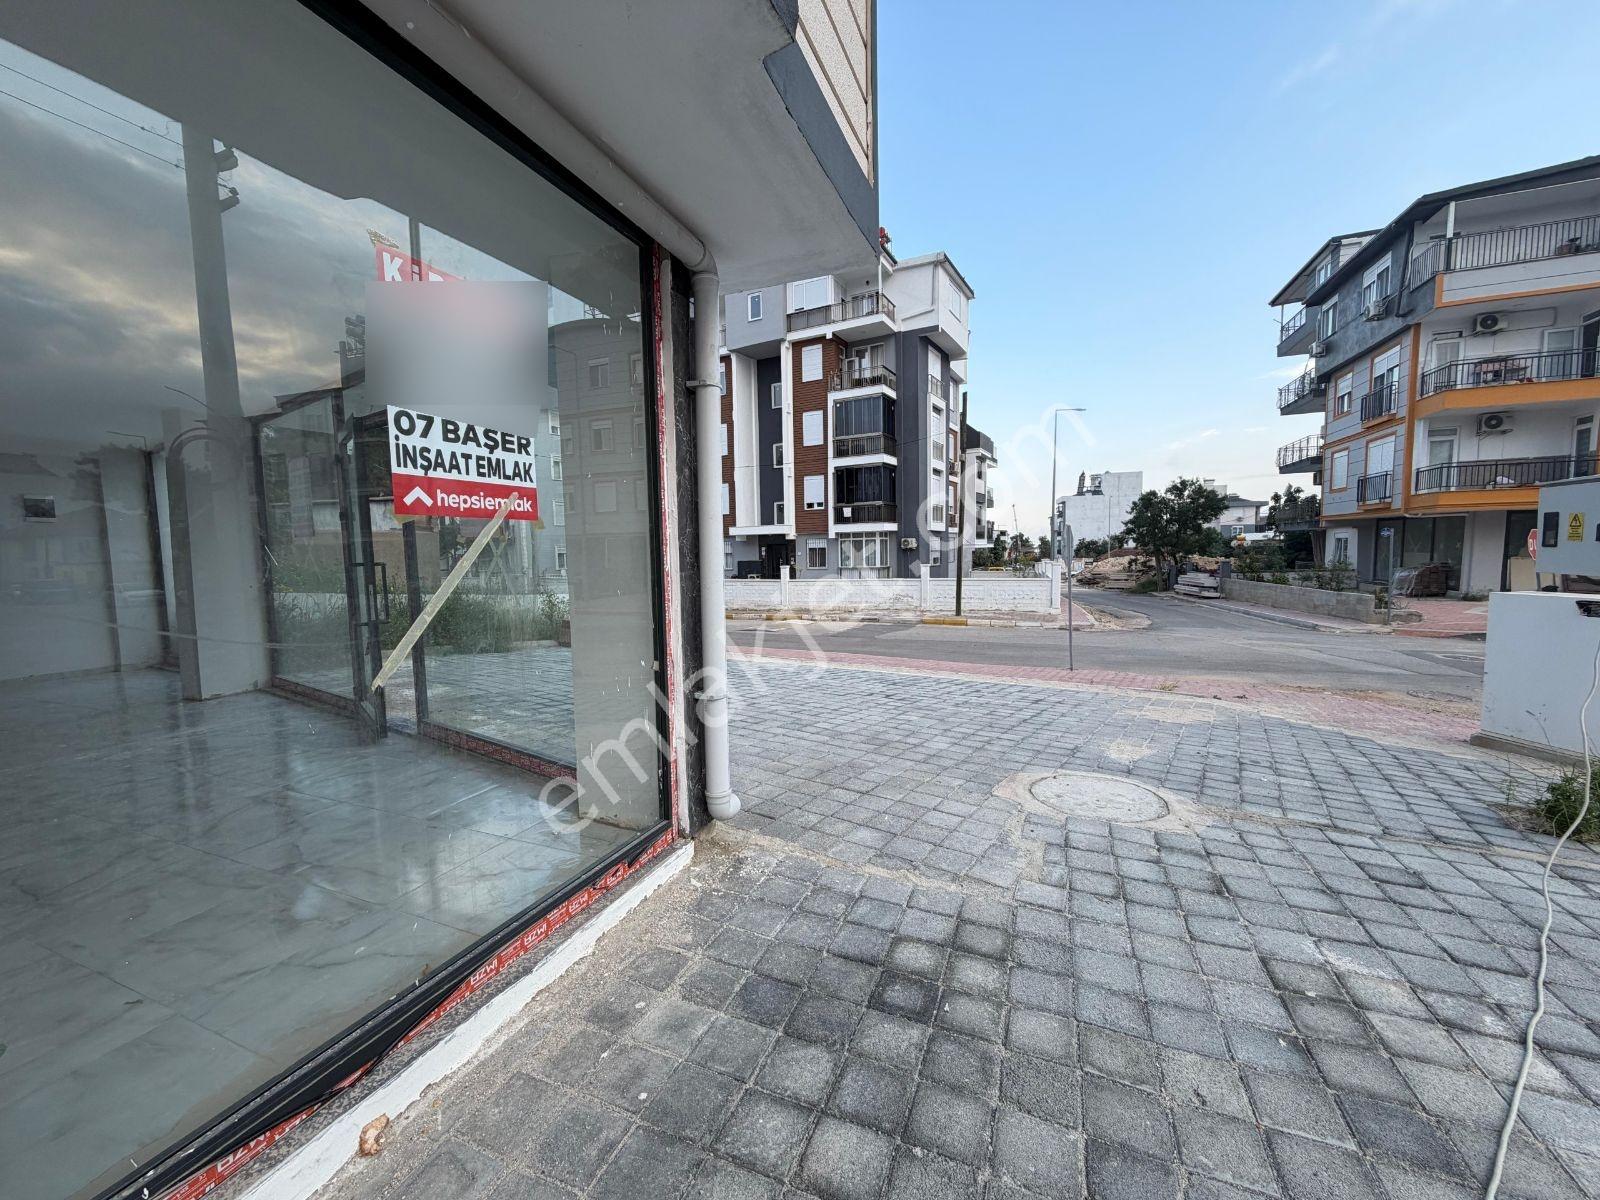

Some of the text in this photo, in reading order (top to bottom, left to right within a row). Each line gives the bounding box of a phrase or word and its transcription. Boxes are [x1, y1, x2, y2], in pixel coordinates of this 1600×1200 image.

[394, 434, 534, 483] İNŞAAT EMLAK
[441, 418, 532, 456] BAŞER
